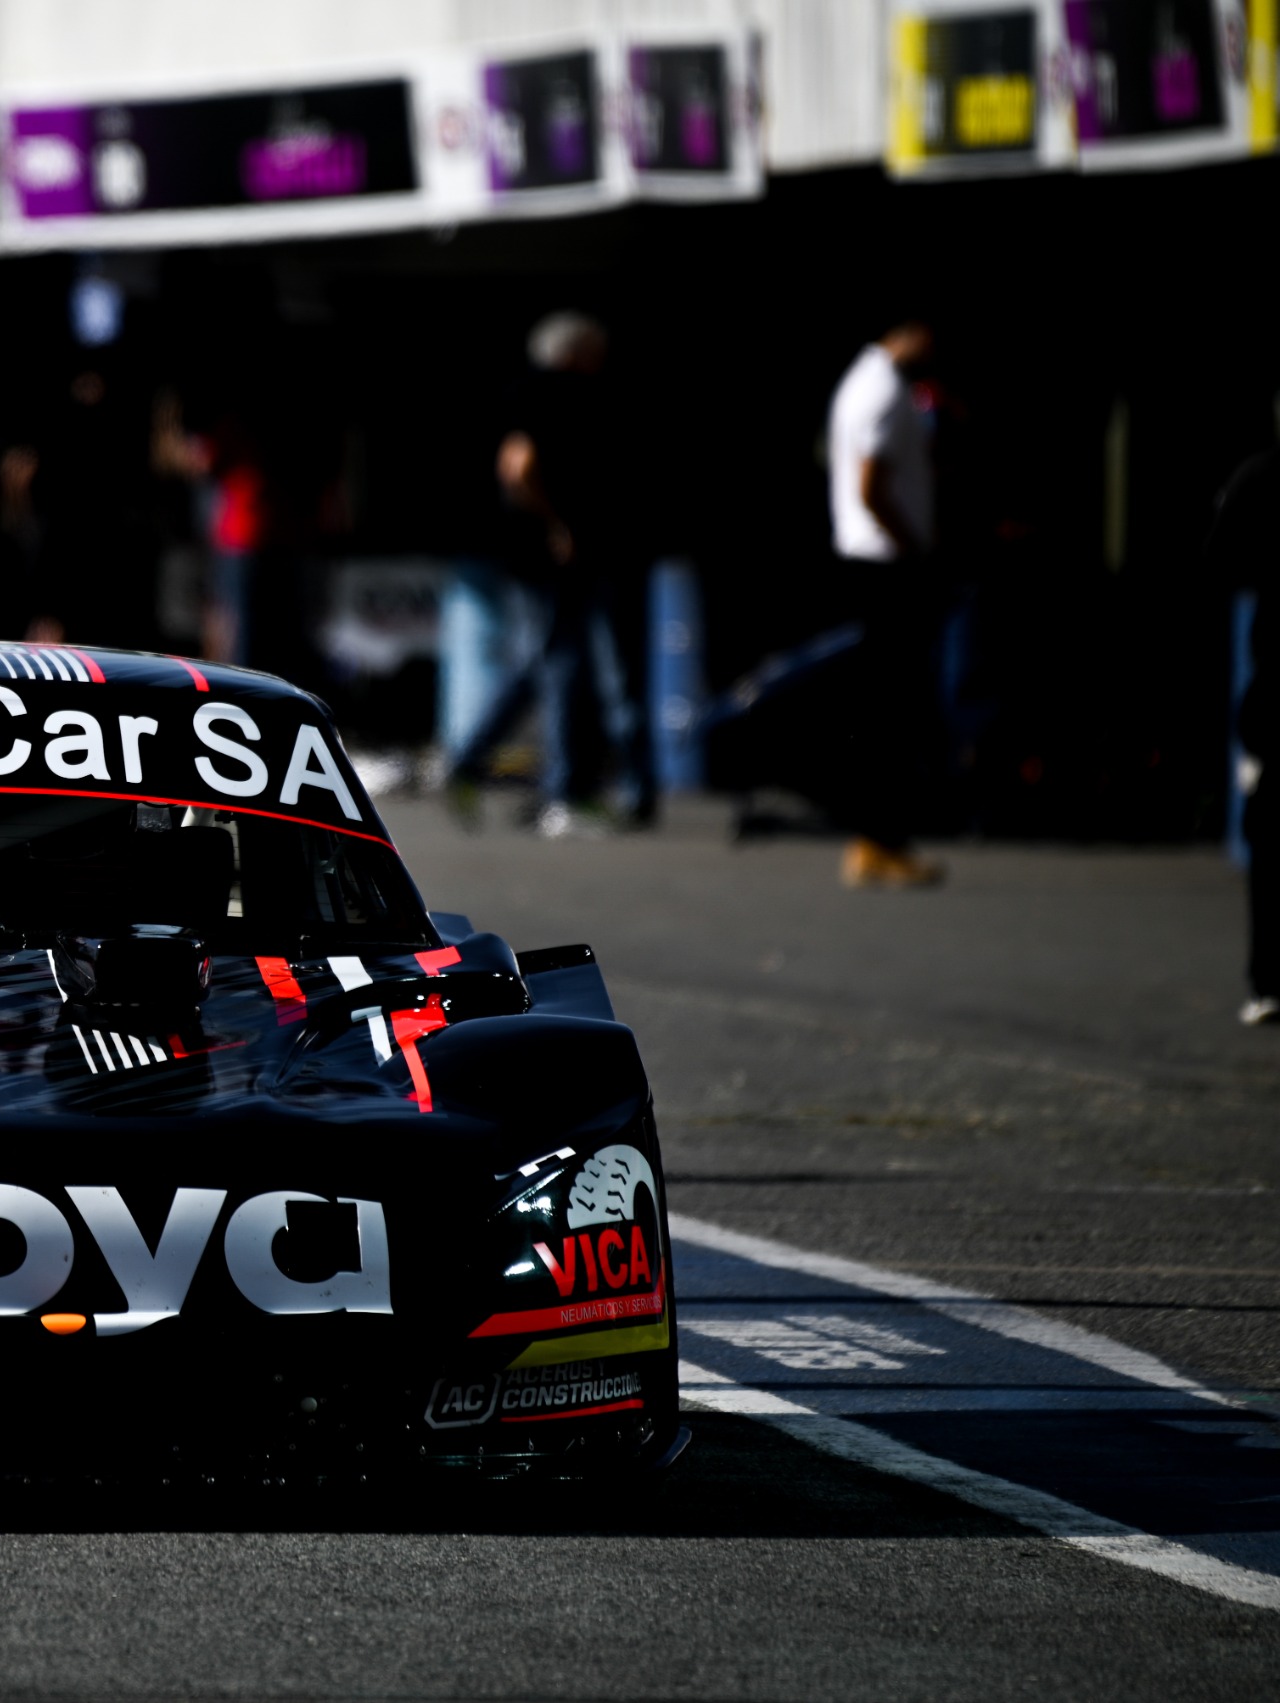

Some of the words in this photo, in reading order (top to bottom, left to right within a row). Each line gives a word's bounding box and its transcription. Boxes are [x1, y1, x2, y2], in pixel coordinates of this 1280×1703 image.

[193, 702, 363, 822] SA
[533, 1226, 652, 1297] VICA
[561, 1301, 624, 1323] NEUMÁTICOS
[625, 1301, 632, 1313] Y
[506, 1361, 594, 1385] ACEROS
[596, 1360, 606, 1377] Y
[441, 1384, 486, 1414] AC
